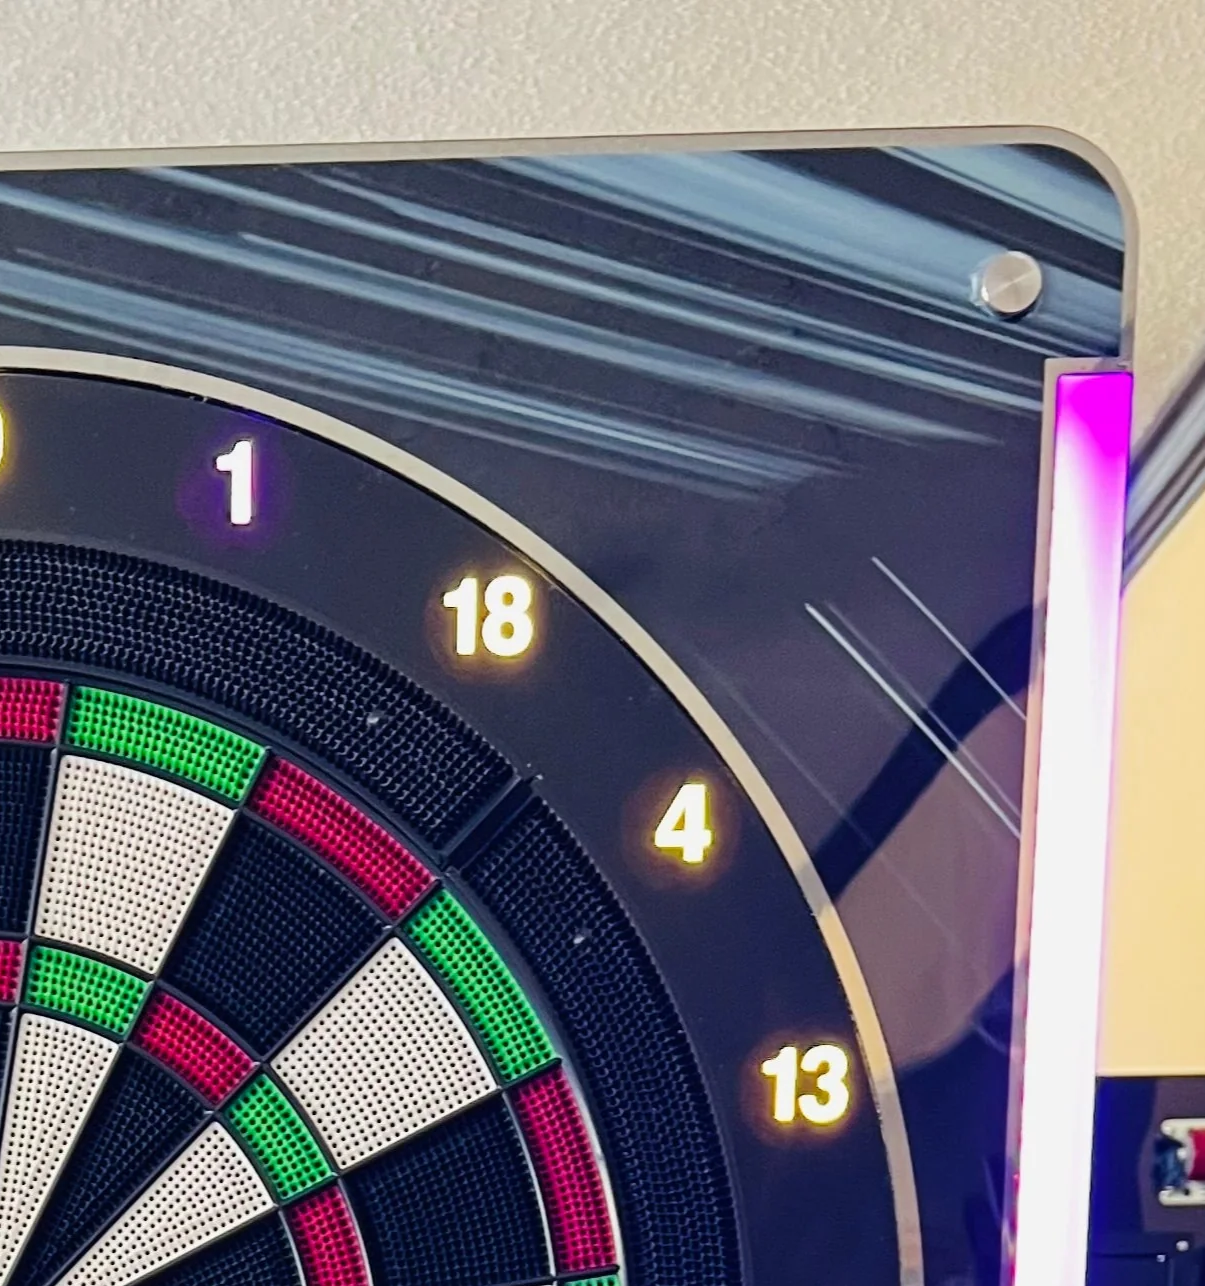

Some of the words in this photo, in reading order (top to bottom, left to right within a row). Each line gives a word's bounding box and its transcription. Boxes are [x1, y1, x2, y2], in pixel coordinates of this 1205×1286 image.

[215, 438, 254, 526] 1
[442, 574, 535, 658] 18
[653, 782, 716, 864] 4
[761, 1043, 850, 1125] 13
